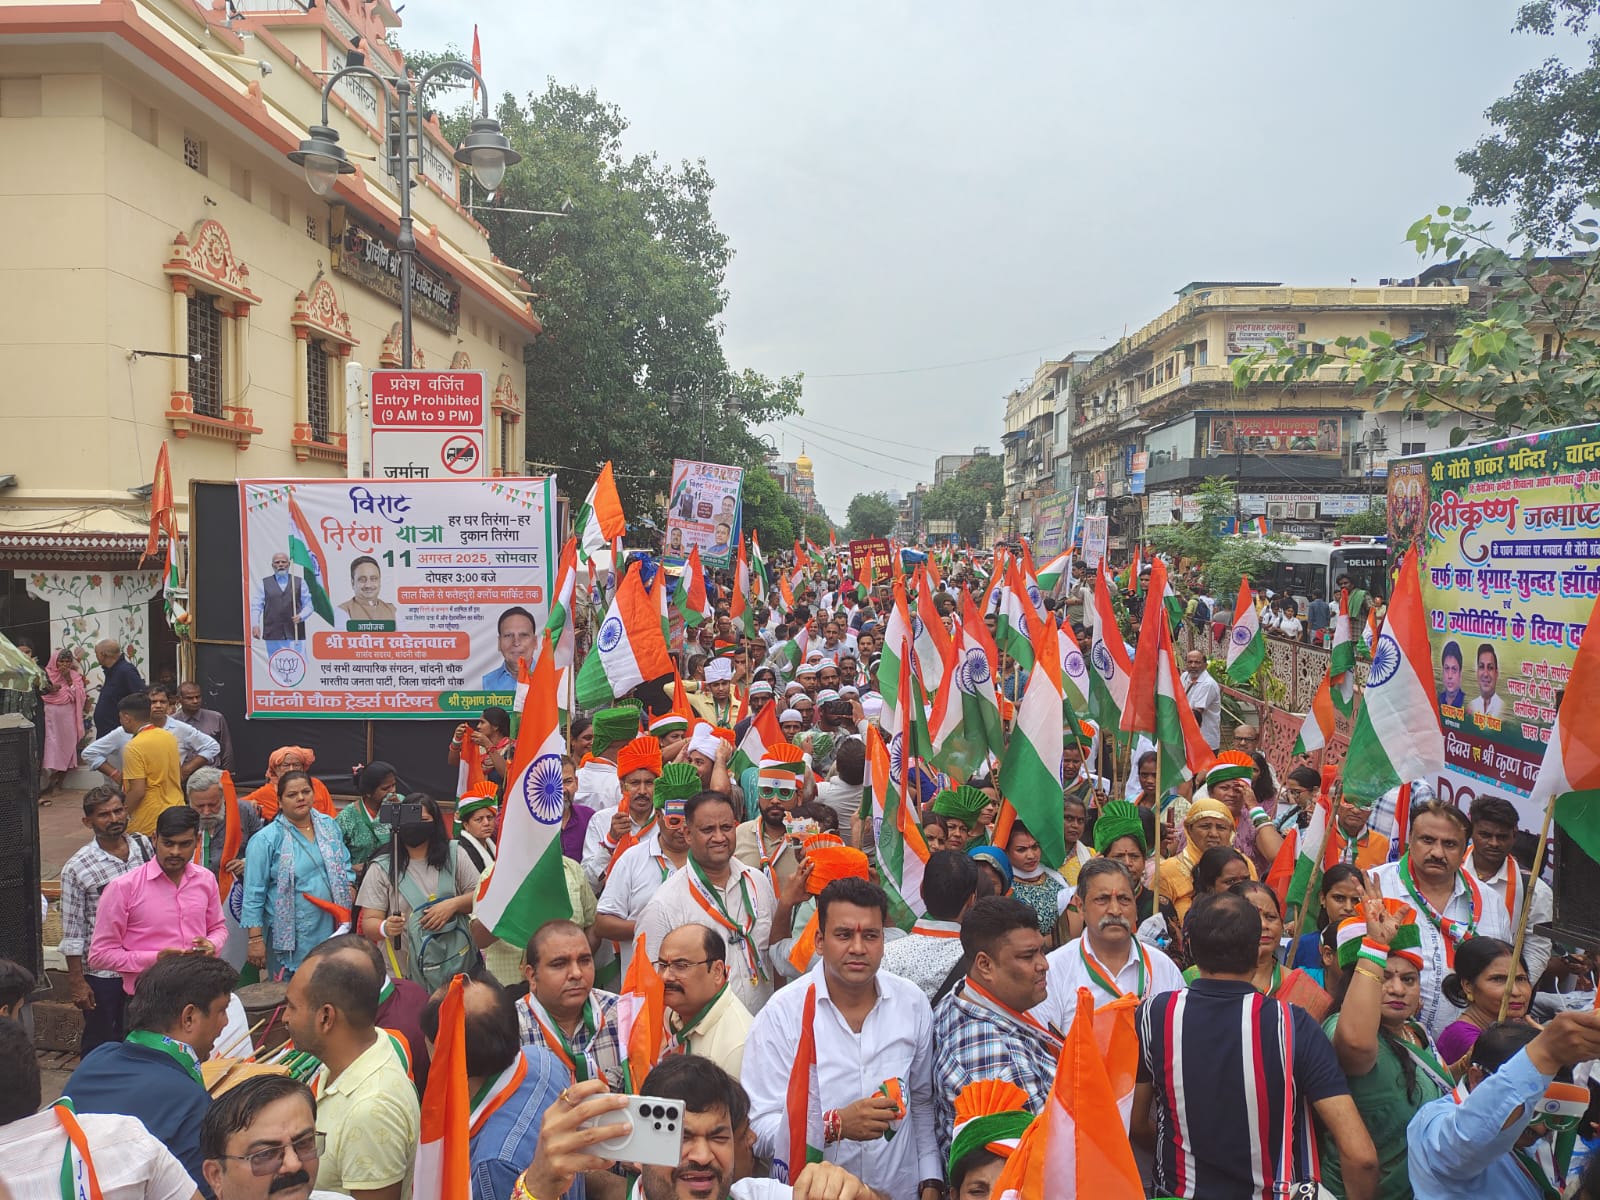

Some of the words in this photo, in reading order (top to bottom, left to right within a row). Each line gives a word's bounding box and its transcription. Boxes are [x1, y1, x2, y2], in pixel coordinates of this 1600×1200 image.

[390, 375, 420, 391] प्रवेश
[428, 375, 464, 391] वर्जित
[375, 394, 409, 408] Entry
[413, 394, 479, 406] Prohibited
[382, 410, 393, 423] (9
[397, 410, 417, 421] AM
[421, 411, 434, 421] to
[438, 410, 445, 421] 9
[449, 410, 473, 424] PM)
[1431, 461, 1445, 481] श्री
[1447, 457, 1471, 479] गौरी
[1474, 454, 1505, 476] शंकर
[1509, 448, 1547, 471] मन्दिर
[349, 487, 412, 524] विराट
[448, 514, 461, 526] हर
[464, 514, 478, 526] घर
[1429, 490, 1520, 563] श्रीकृष्ण
[320, 516, 383, 554] तिरंगा
[396, 525, 445, 544] यात्रा
[460, 530, 488, 545] दुकान
[490, 527, 519, 542] तिरंगा
[1283, 525, 1305, 533] ELGIN
[1564, 541, 1573, 556] श्री
[382, 551, 411, 567] 11
[418, 553, 452, 564] अगस्त
[494, 551, 538, 563] सोमवार
[1350, 559, 1375, 567] DELHI
[425, 570, 453, 583] दोपहर
[456, 573, 478, 583] 3:00
[1430, 563, 1452, 587] बर्फ
[1454, 569, 1473, 588] का
[401, 591, 417, 600] लाल
[419, 588, 435, 600] किले
[437, 588, 444, 600] से
[525, 590, 539, 599] तक
[358, 623, 385, 631] आयोजक
[1431, 610, 1445, 629] 12
[1511, 612, 1526, 639] के
[1530, 613, 1564, 644] दिव्य
[326, 635, 344, 649] श्री
[347, 634, 385, 649] प्रवीन
[321, 663, 332, 674] एवं
[333, 663, 350, 674] सभी
[352, 663, 388, 674] व्यापारिक
[390, 663, 417, 675] संगठन,
[419, 663, 444, 674] चांदनी
[445, 663, 463, 674] चौक
[1521, 662, 1534, 677] आप
[1536, 660, 1548, 679] सभी
[320, 677, 349, 688] भारतीय
[351, 678, 374, 688] जनता
[398, 676, 419, 688] जिला
[421, 677, 446, 688] चांदनी
[448, 677, 465, 688] चौक
[256, 693, 305, 708] चांदनी
[307, 693, 342, 708] चौक
[343, 693, 383, 710] ट्रेडर्स
[384, 693, 433, 708] परिषद
[448, 694, 460, 706] श्री
[460, 695, 485, 710] सुभाष
[1446, 732, 1471, 759] दिवस
[1482, 745, 1494, 768] श्री
[1496, 753, 1520, 779] कृष्ण
